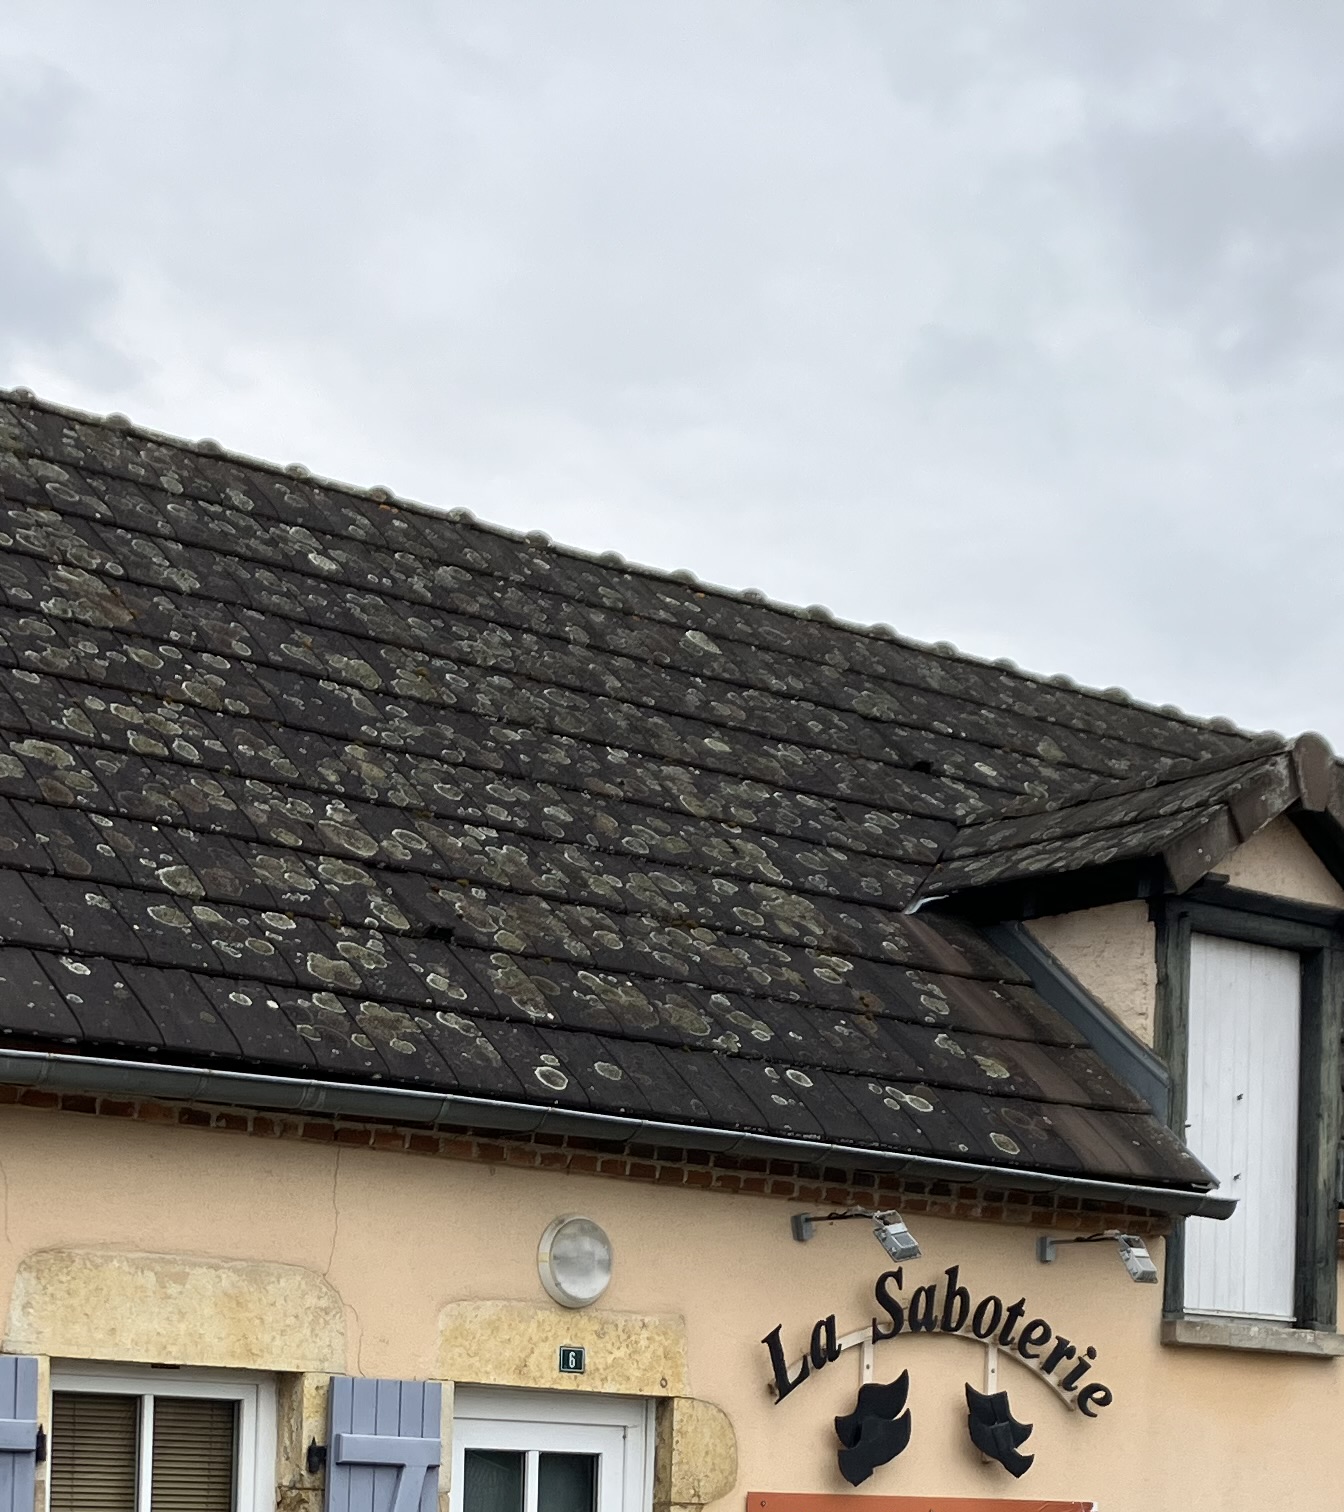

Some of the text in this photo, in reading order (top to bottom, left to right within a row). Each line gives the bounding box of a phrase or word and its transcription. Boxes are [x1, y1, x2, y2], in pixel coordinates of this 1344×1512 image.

[569, 1351, 576, 1369] 6
[761, 1264, 1113, 1418] La Saboterie
